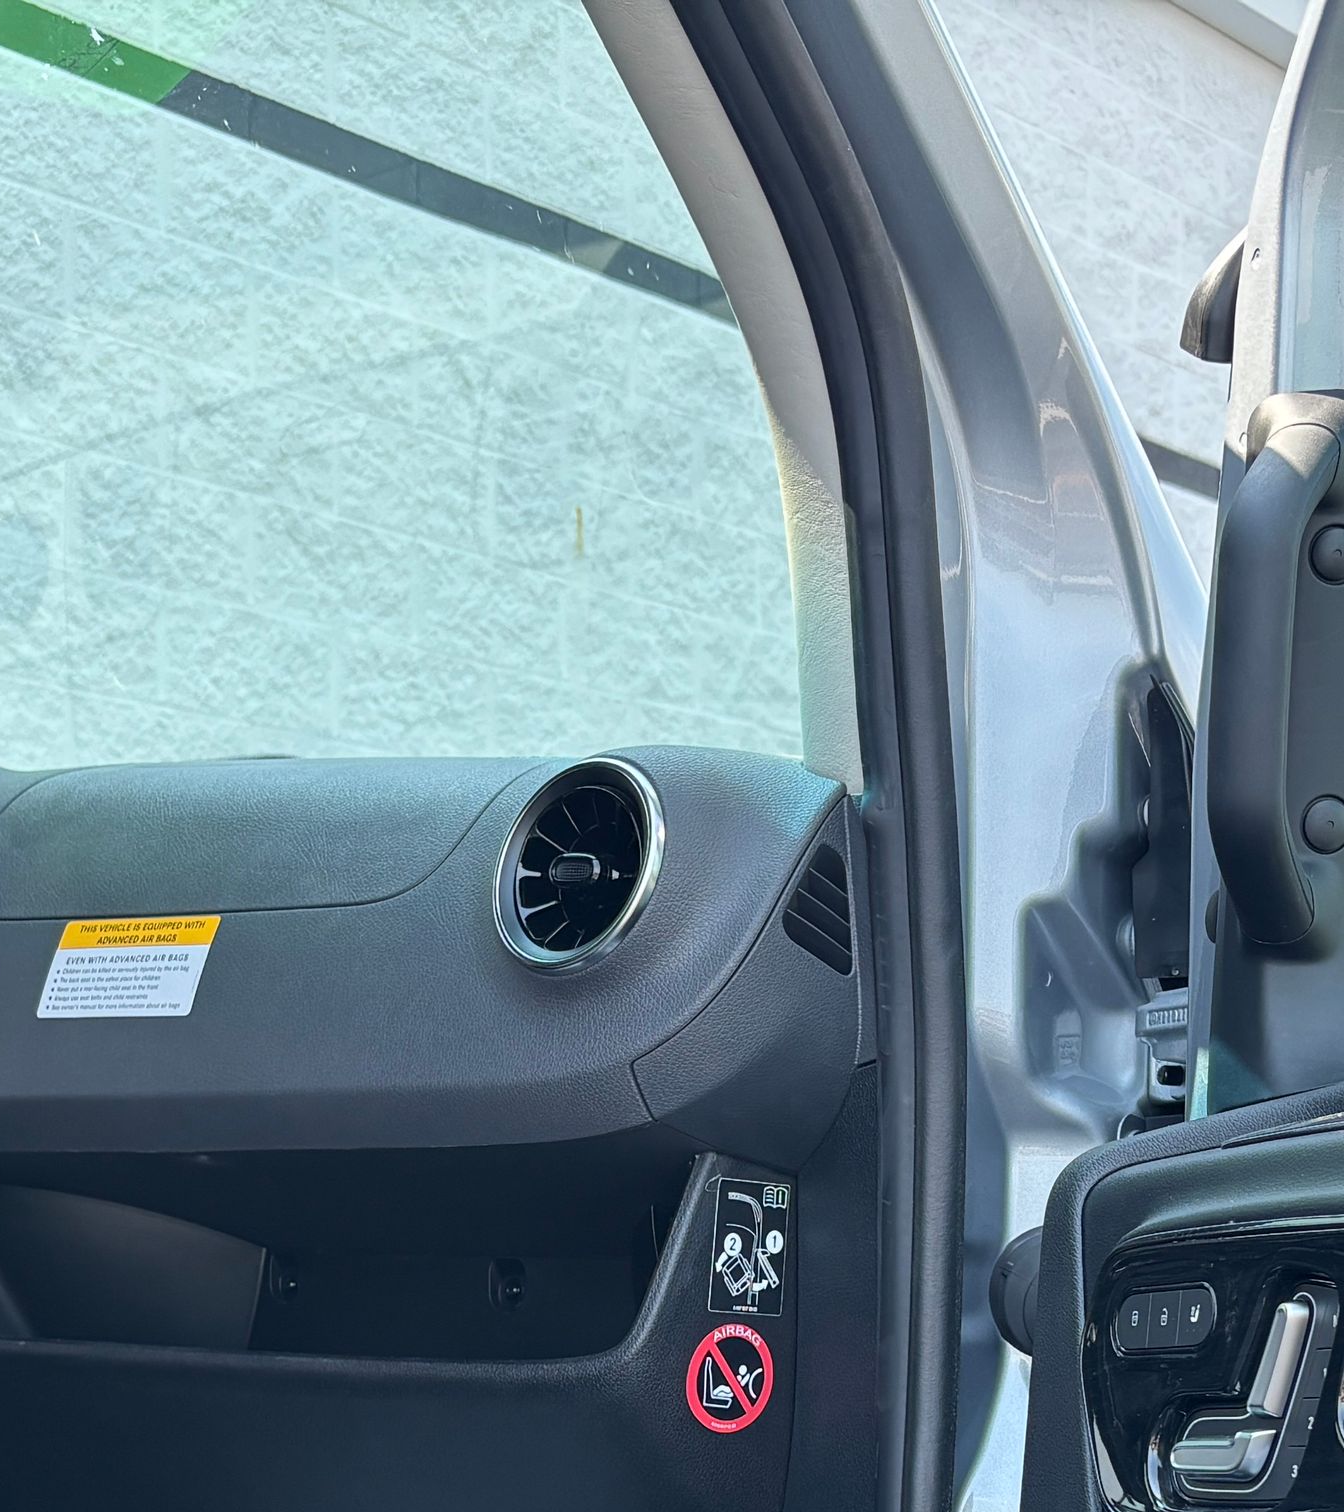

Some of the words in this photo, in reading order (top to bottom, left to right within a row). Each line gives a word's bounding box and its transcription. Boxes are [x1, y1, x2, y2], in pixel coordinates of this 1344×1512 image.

[80, 924, 99, 934] THIS
[99, 923, 131, 933] VEHICLE
[132, 923, 141, 931] IS
[142, 922, 183, 931] EQUIPPED
[184, 920, 206, 929] WITH
[96, 935, 139, 945] ADVANCED
[140, 935, 155, 944] AIR
[156, 934, 178, 943] BAGS
[66, 957, 86, 965] EVEN
[88, 956, 107, 965] WITH
[108, 954, 151, 963] ADVANCED
[151, 954, 166, 962] AIR
[167, 953, 190, 962] BAGS
[727, 1237, 738, 1252] 2
[713, 1325, 761, 1347] AIRBAG
